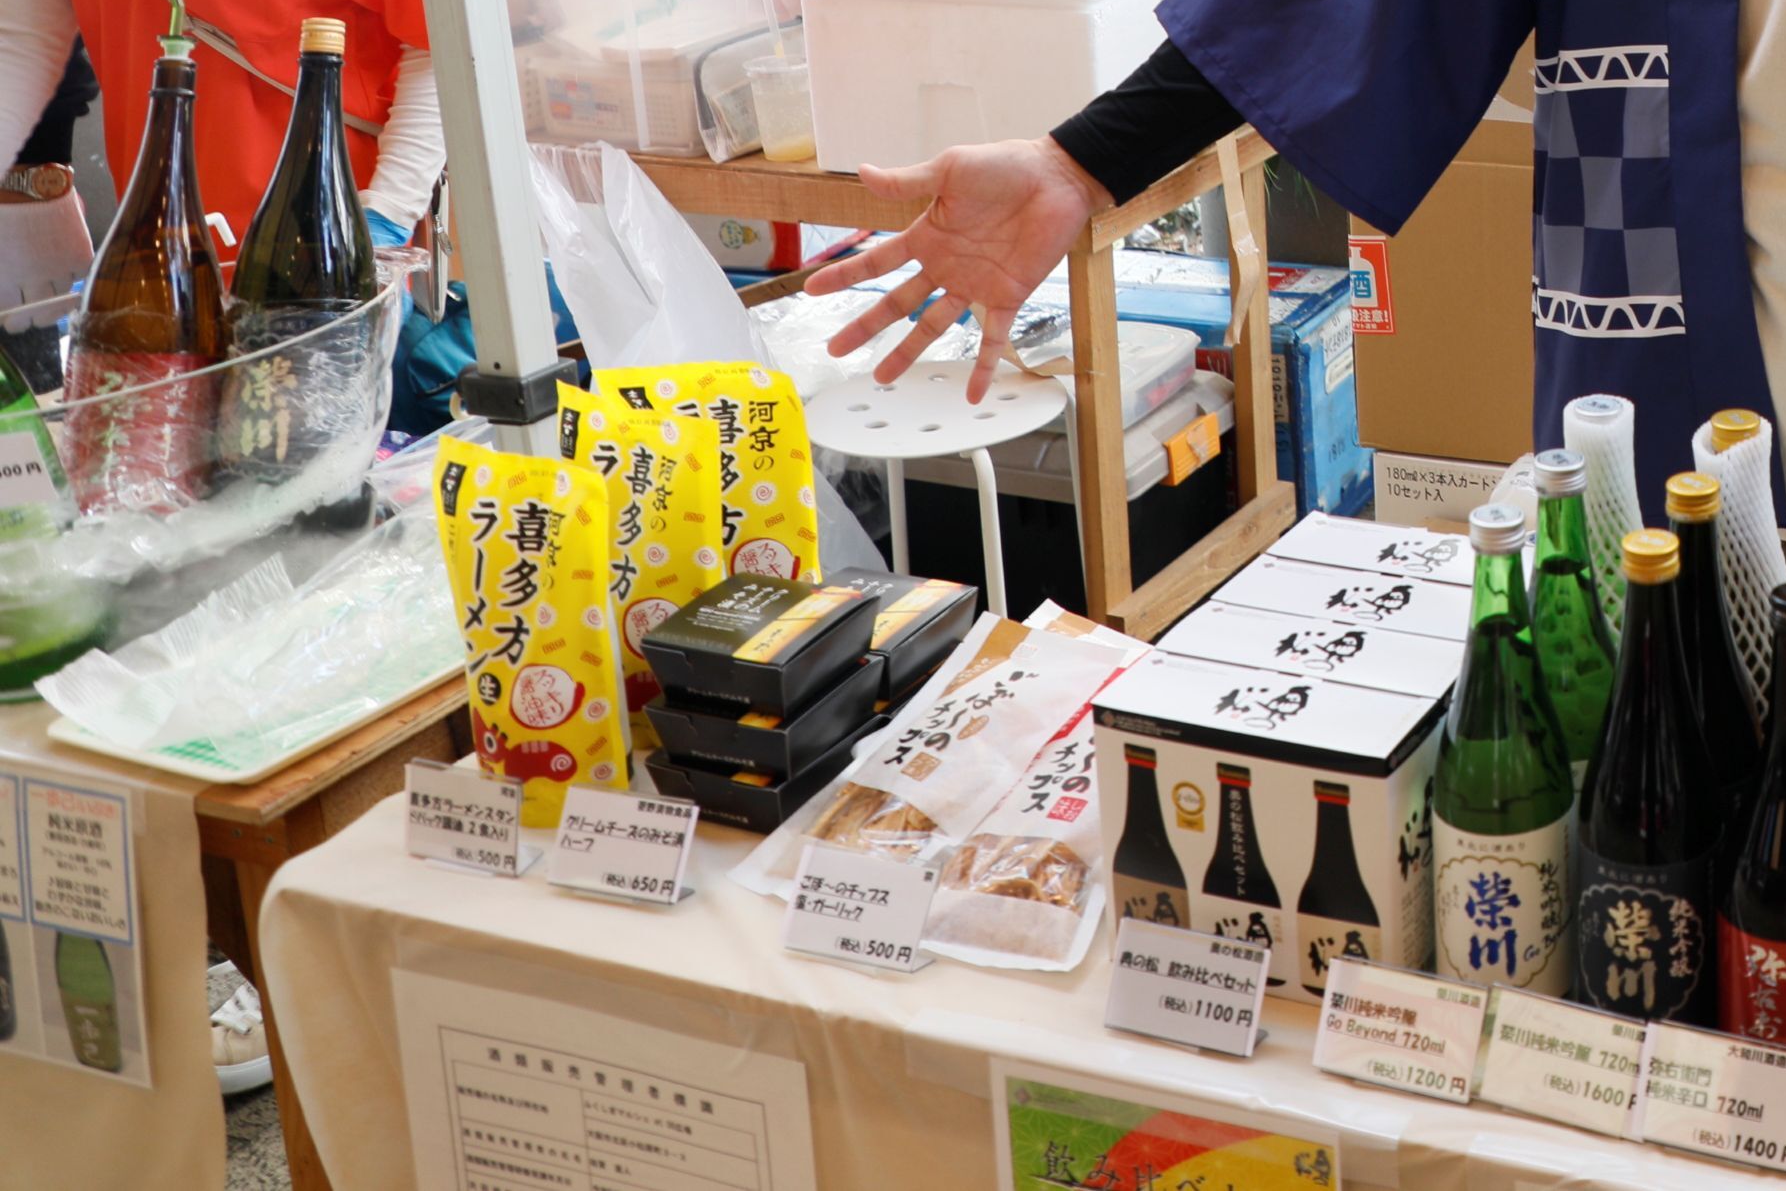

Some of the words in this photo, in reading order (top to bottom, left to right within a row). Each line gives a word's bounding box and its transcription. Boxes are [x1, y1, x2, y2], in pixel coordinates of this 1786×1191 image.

[1387, 483, 1445, 502] 10セット入
[610, 446, 653, 602] 喜多方
[463, 502, 498, 674] ラーメン
[494, 501, 548, 667] 喜多方
[480, 677, 500, 703] 生
[560, 836, 595, 851] ハーフ
[504, 855, 516, 871] 円
[661, 879, 674, 896] 円
[896, 946, 912, 964] 円
[1120, 950, 1160, 974] 奥の松
[1167, 960, 1257, 993] 飲み比べセット
[1237, 1008, 1254, 1028] 円
[1326, 1013, 1343, 1031] Go
[1345, 1018, 1397, 1044] Beyond
[1402, 1031, 1446, 1054] 720ml
[1451, 1076, 1467, 1095] 円
[1648, 1056, 1713, 1087] 弥右衛門
[1645, 1080, 1708, 1109] 純米辛口
[1716, 1095, 1765, 1121] 720ml
[1042, 1140, 1234, 1191] 飲み比べ
